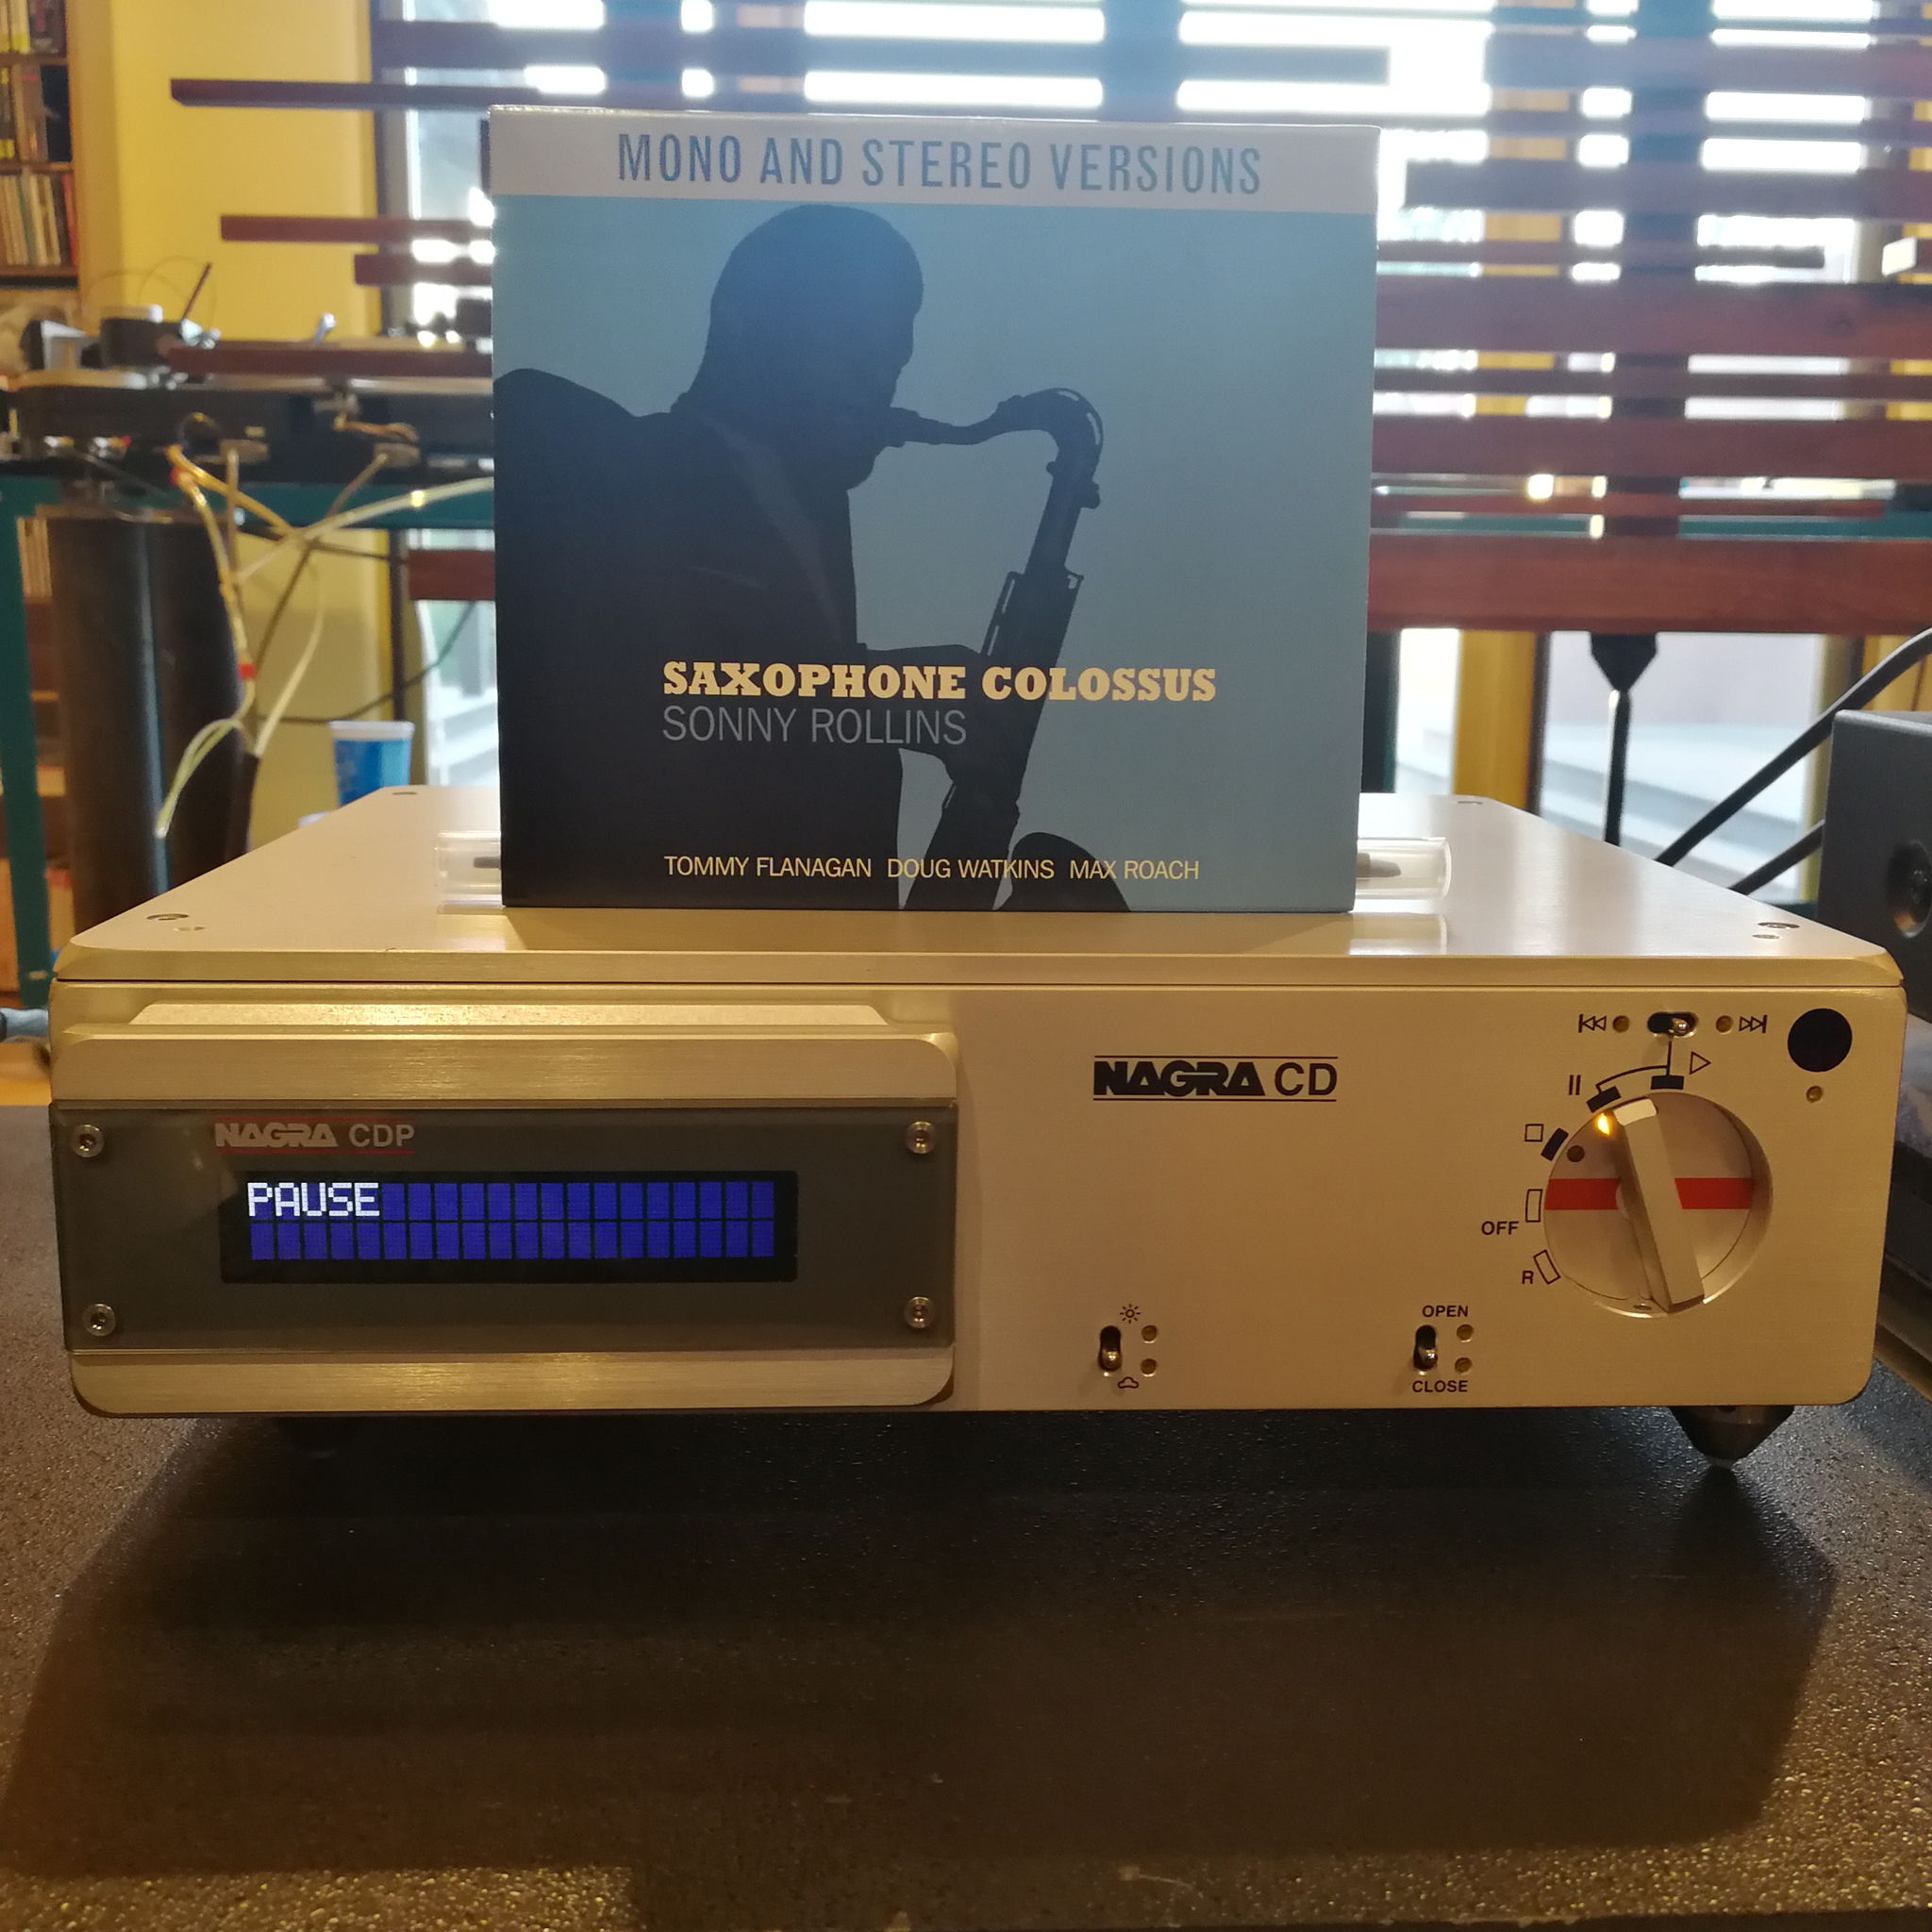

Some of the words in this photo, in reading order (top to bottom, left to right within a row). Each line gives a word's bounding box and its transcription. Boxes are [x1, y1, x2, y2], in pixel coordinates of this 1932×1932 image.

[617, 133, 742, 184] MONO
[758, 137, 843, 187] AND
[860, 139, 1031, 192] STEREO
[1050, 143, 1262, 194] VERSIONS
[663, 660, 967, 700] SAXOPHONE
[981, 666, 1217, 702] COLOSSUS
[662, 705, 797, 743] SONNY
[810, 708, 967, 745] ROLLINS
[664, 856, 749, 877] TOMMY
[757, 857, 873, 878] FLANAGAN
[887, 858, 952, 880] DOUG
[958, 858, 1056, 880] WATKINS
[1069, 859, 1117, 880] MAX
[1124, 859, 1200, 880] ROACH
[1092, 1059, 1266, 1098] NAGRA
[1274, 1061, 1338, 1096] CD
[214, 1122, 339, 1148] NAGRA
[348, 1123, 416, 1148] CDP
[246, 1181, 381, 1218] PAUSE
[1481, 1222, 1519, 1236] OFF
[1521, 1270, 1535, 1285] R
[1422, 1304, 1469, 1318] OPEN
[1411, 1379, 1469, 1393] CLOSE
